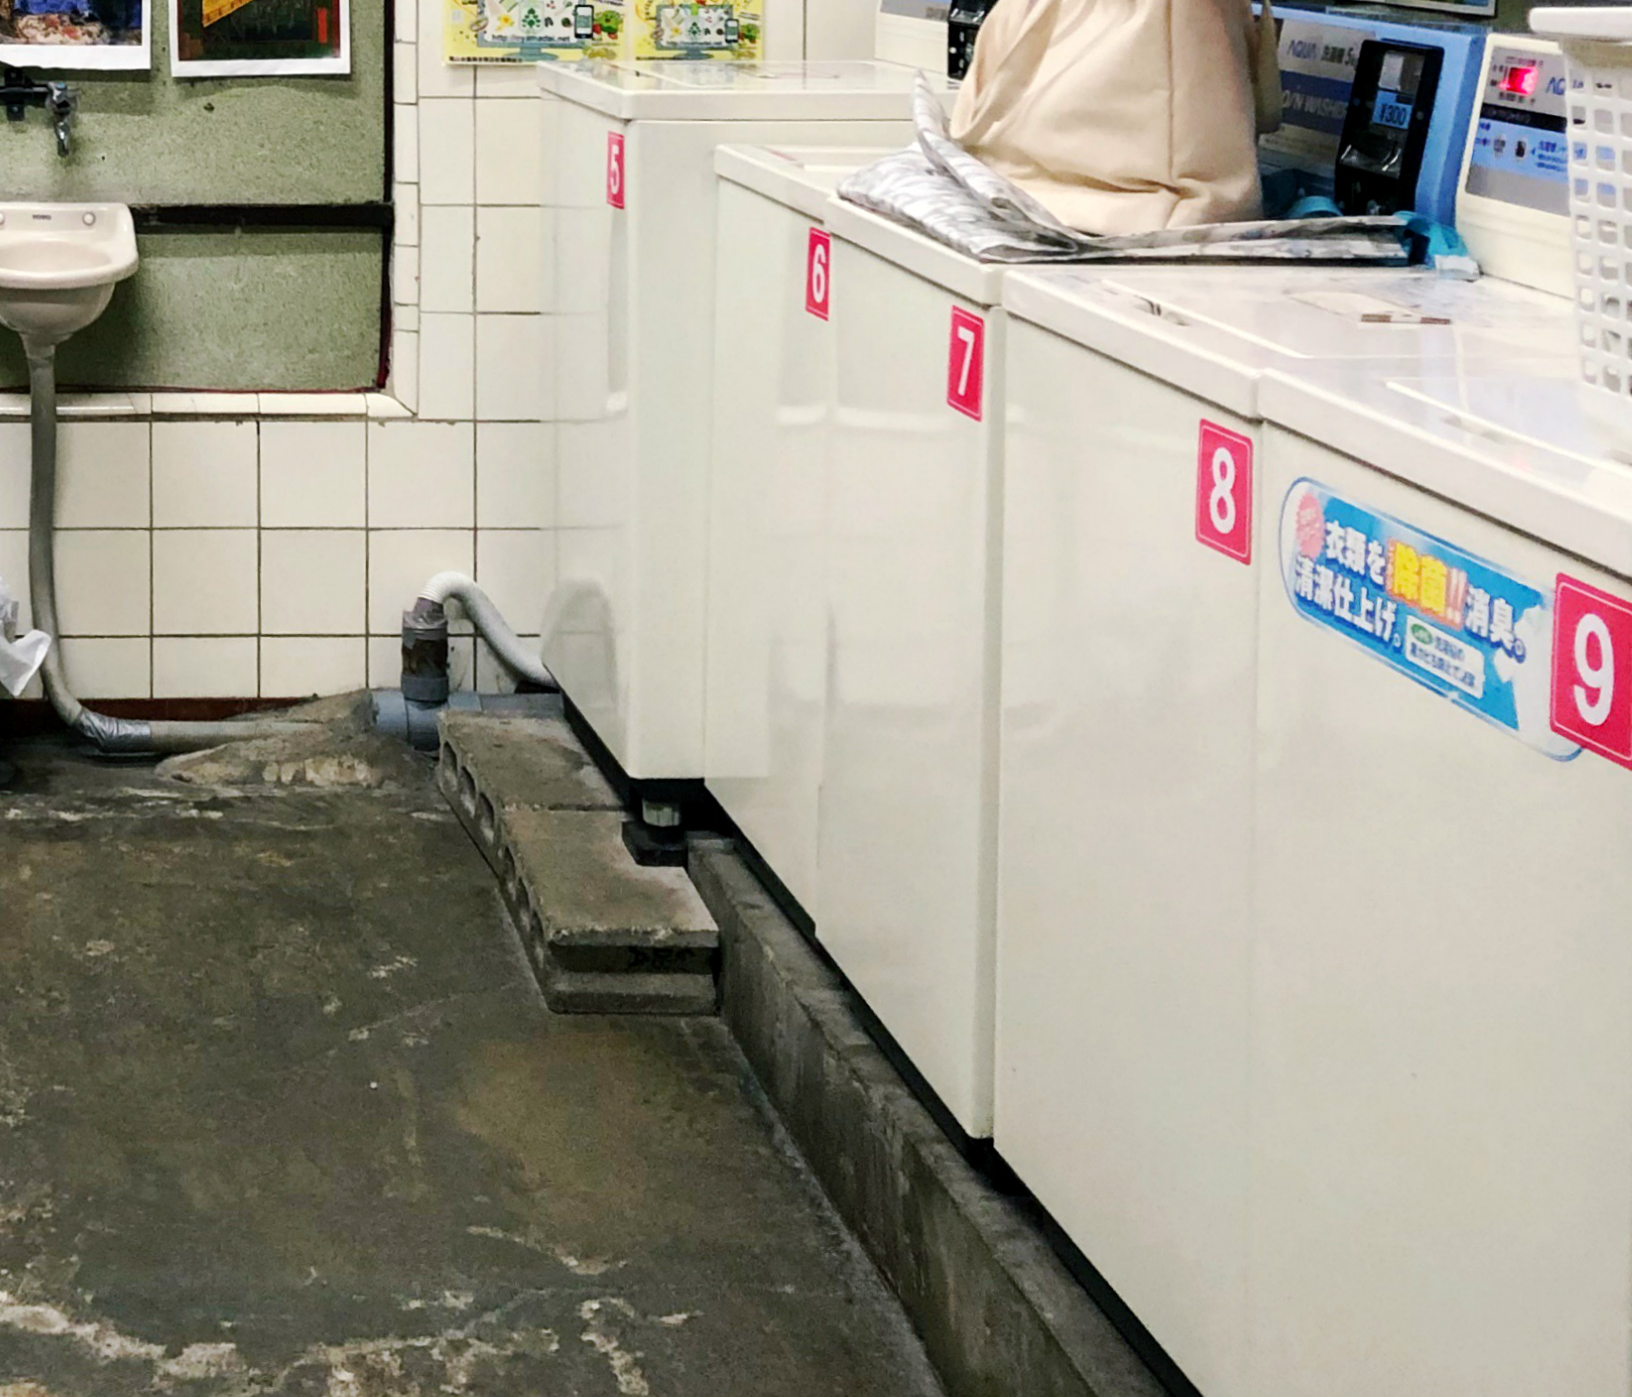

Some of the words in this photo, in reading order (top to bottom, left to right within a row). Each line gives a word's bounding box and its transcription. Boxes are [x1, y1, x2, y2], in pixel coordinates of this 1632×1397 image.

[1379, 102, 1408, 126] ¥300
[608, 143, 621, 195] 5
[811, 243, 826, 304] 6
[957, 326, 975, 397] 7
[1209, 446, 1237, 535] 8
[1295, 554, 1401, 648] 清潔仕上げ。
[1572, 612, 1615, 727] 9
